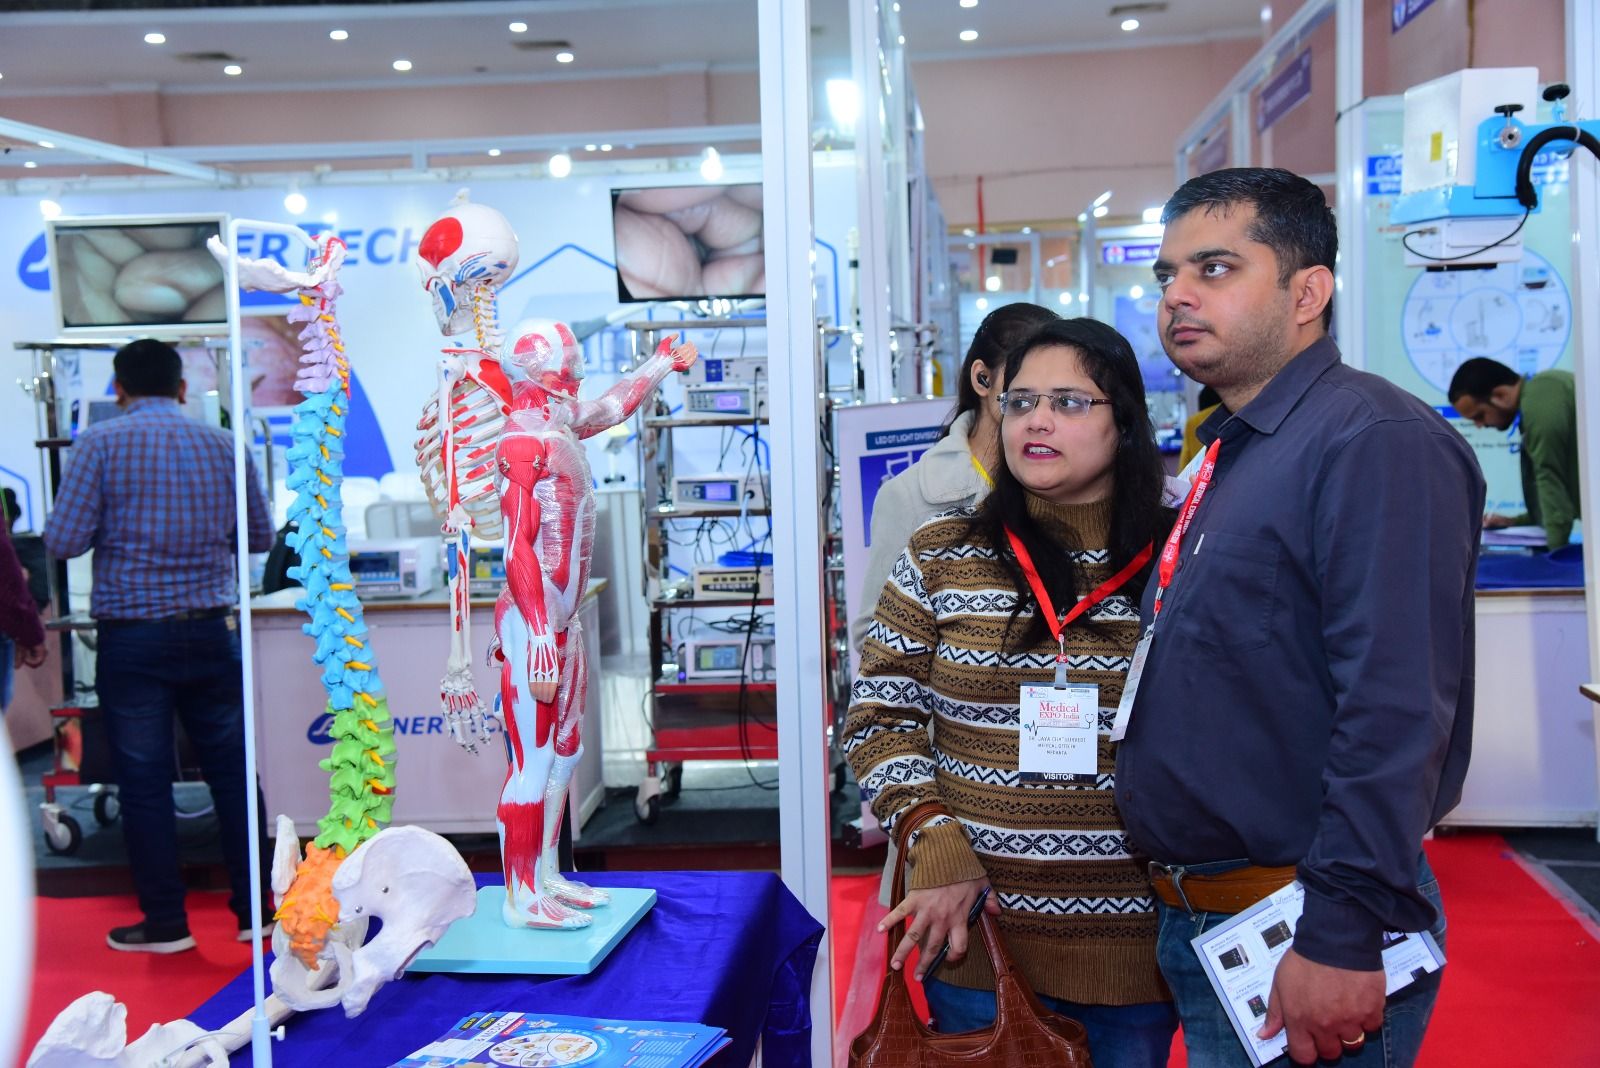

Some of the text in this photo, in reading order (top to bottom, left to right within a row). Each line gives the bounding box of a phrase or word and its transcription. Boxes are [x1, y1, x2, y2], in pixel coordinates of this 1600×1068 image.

[1039, 702, 1079, 712] Medical
[1063, 712, 1080, 720] India
[1044, 773, 1074, 781] VISITOR
